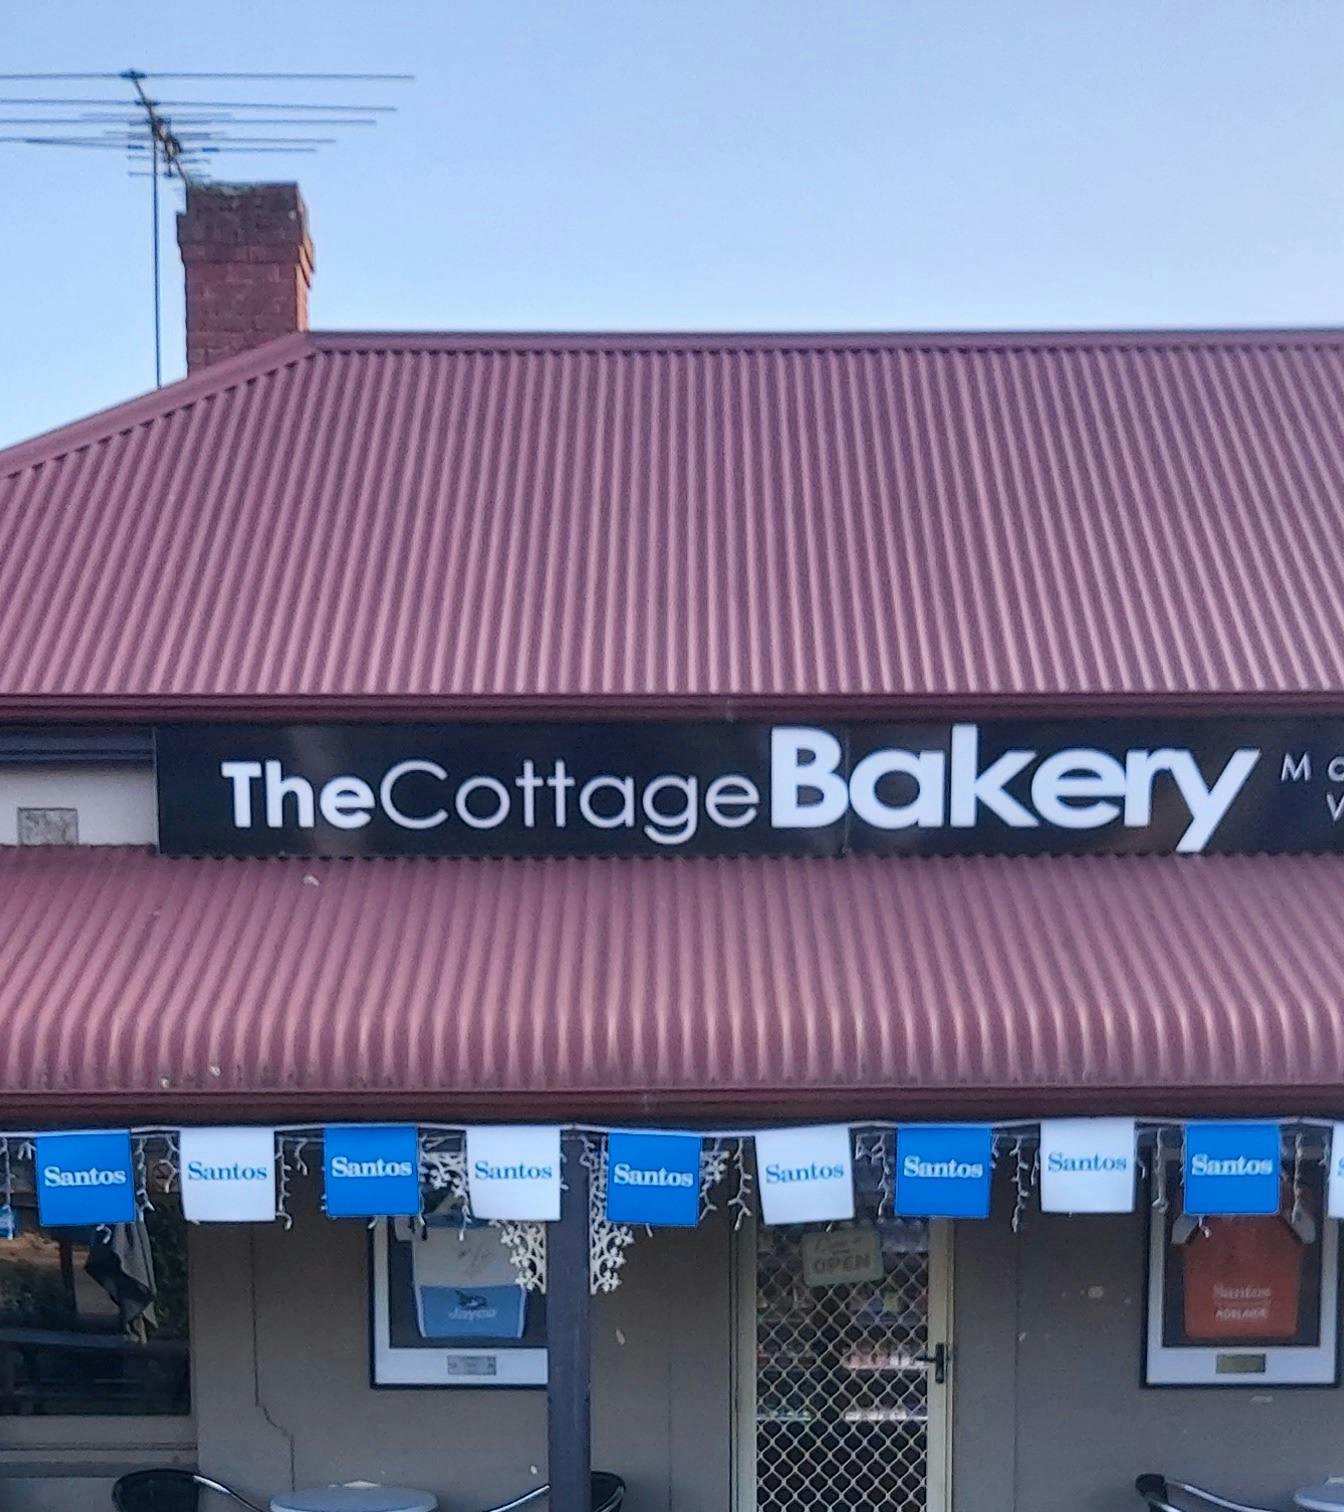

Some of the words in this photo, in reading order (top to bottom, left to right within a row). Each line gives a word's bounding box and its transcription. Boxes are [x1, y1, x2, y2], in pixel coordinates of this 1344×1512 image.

[771, 725, 1259, 852] Bakery
[187, 1161, 268, 1181] Santos
[331, 1156, 414, 1178] Santos
[474, 1161, 553, 1180] Santos
[902, 1155, 985, 1178] Santos
[1047, 1153, 1128, 1172] Santos
[1189, 1155, 1273, 1176] Santos
[43, 1166, 129, 1188] Santos
[613, 1164, 694, 1187] Santos
[765, 1164, 845, 1184] Santos
